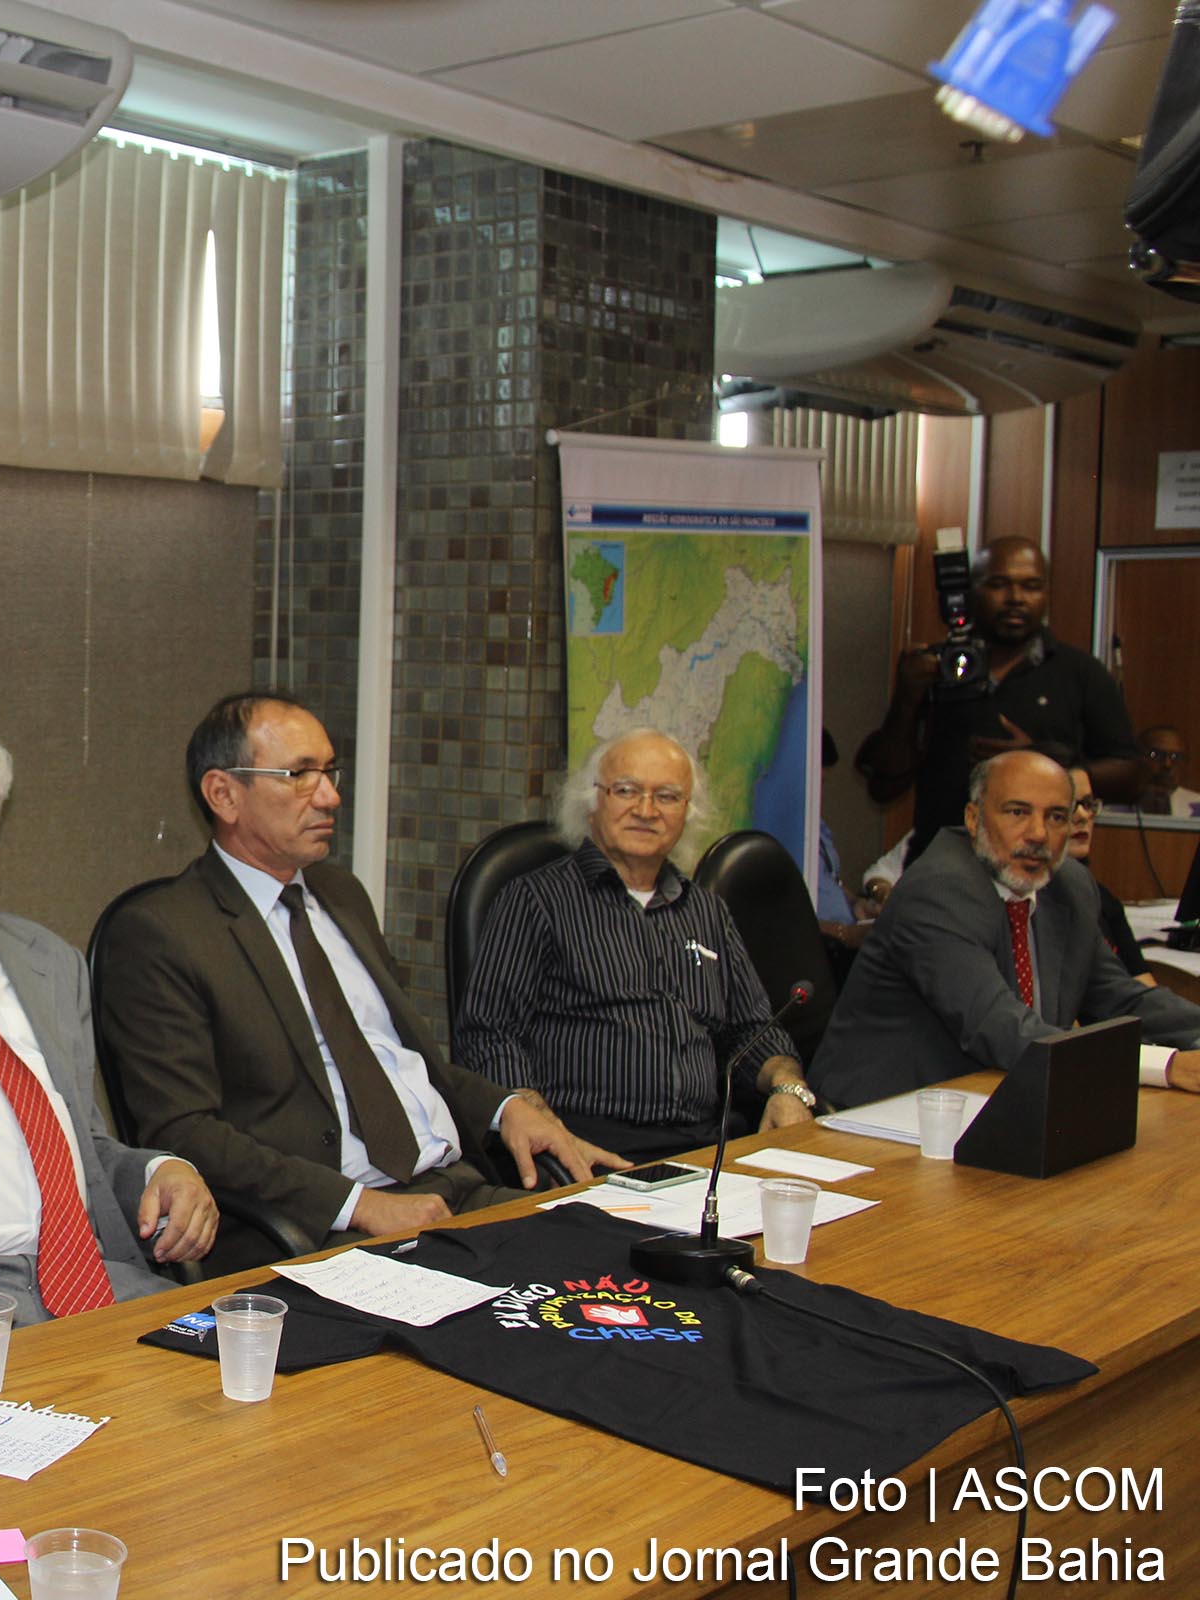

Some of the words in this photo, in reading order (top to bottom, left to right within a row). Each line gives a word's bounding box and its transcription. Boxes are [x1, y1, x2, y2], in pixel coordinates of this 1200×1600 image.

[491, 1283, 557, 1312] DIGO
[673, 1311, 702, 1325] DA
[567, 1326, 705, 1343] CHESF
